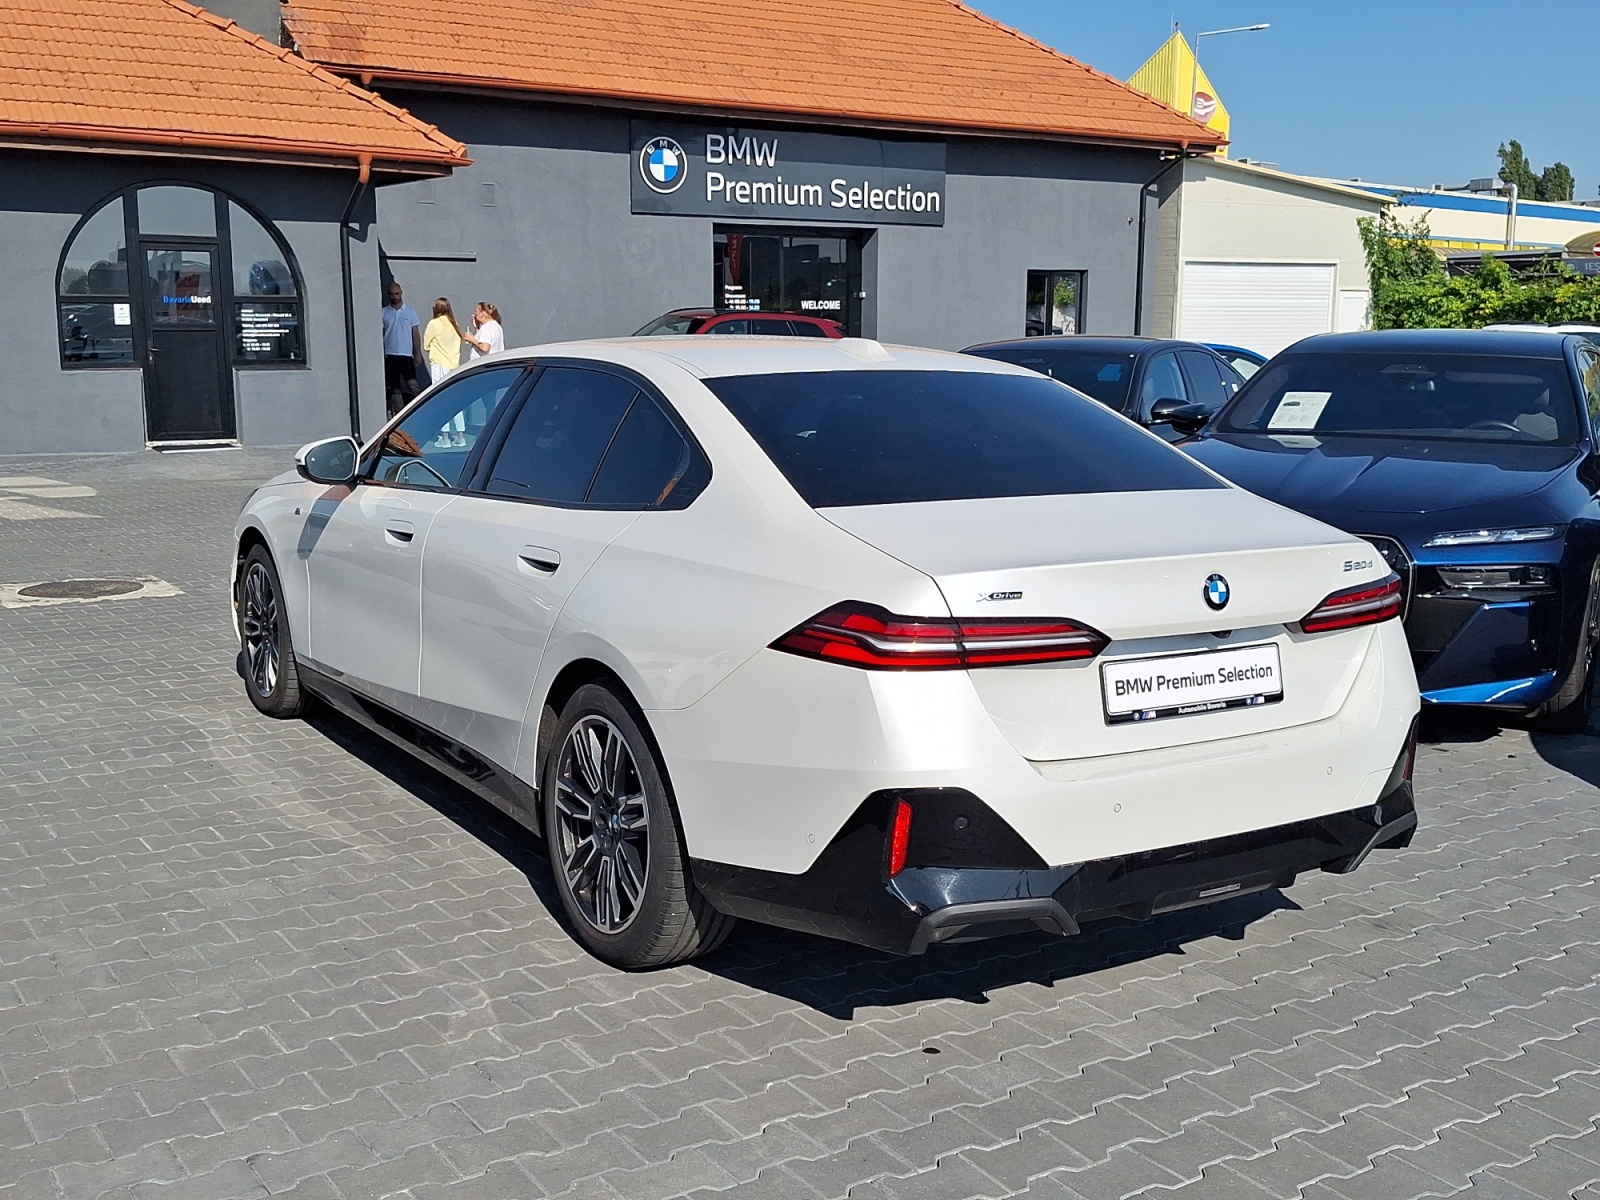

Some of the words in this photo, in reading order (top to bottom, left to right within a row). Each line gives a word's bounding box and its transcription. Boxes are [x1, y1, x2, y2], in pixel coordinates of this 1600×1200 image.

[646, 140, 681, 156] BMW
[705, 134, 778, 167] BMW
[706, 171, 822, 207] Premium
[829, 178, 940, 213] Selection
[163, 295, 212, 304] BavariaUsed
[801, 300, 841, 310] WELCOME
[1342, 560, 1373, 573] 520d
[1115, 676, 1153, 696] BMW
[1157, 671, 1215, 691] Premium
[1218, 663, 1273, 684] Selection
[1178, 704, 1207, 714] Automobile
[1207, 701, 1227, 711] Bavaria
